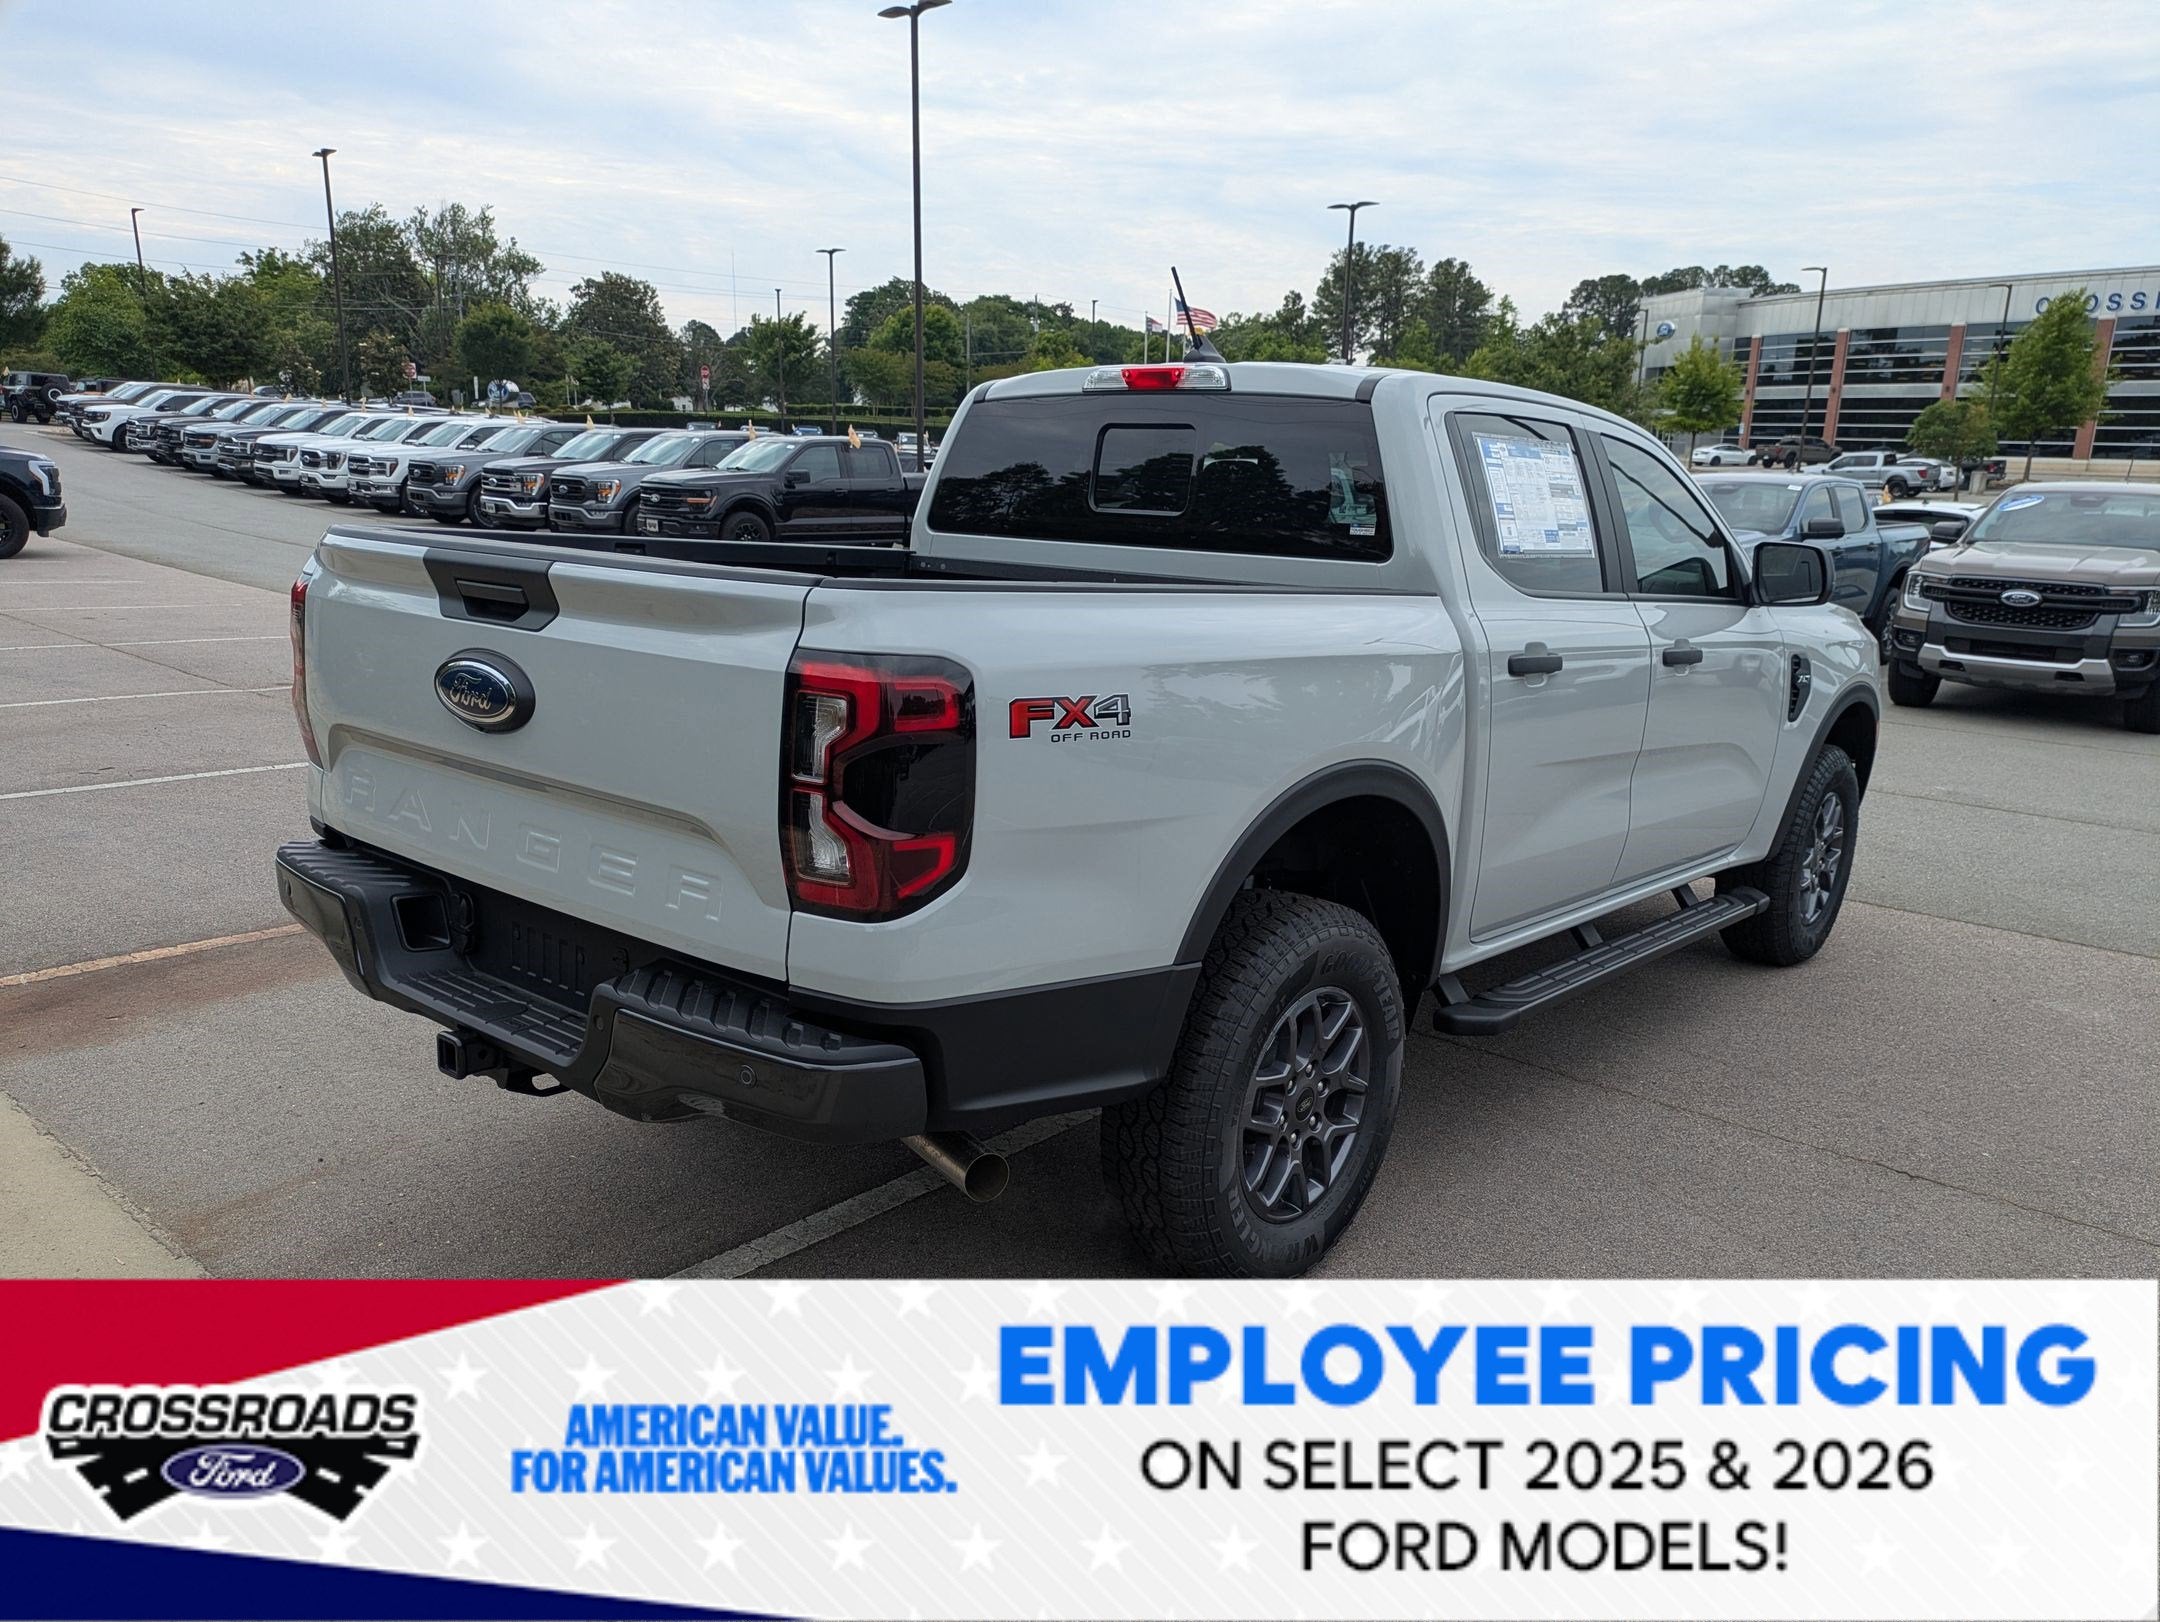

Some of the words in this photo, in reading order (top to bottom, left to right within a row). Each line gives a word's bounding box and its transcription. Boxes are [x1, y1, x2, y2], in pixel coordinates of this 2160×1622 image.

[2035, 290, 2160, 315] COSS
[449, 672, 493, 710] Ford
[1009, 693, 1132, 739] FX4
[1050, 732, 1084, 743] OFF
[1089, 729, 1131, 741] ROAD
[345, 770, 724, 922] RANGER
